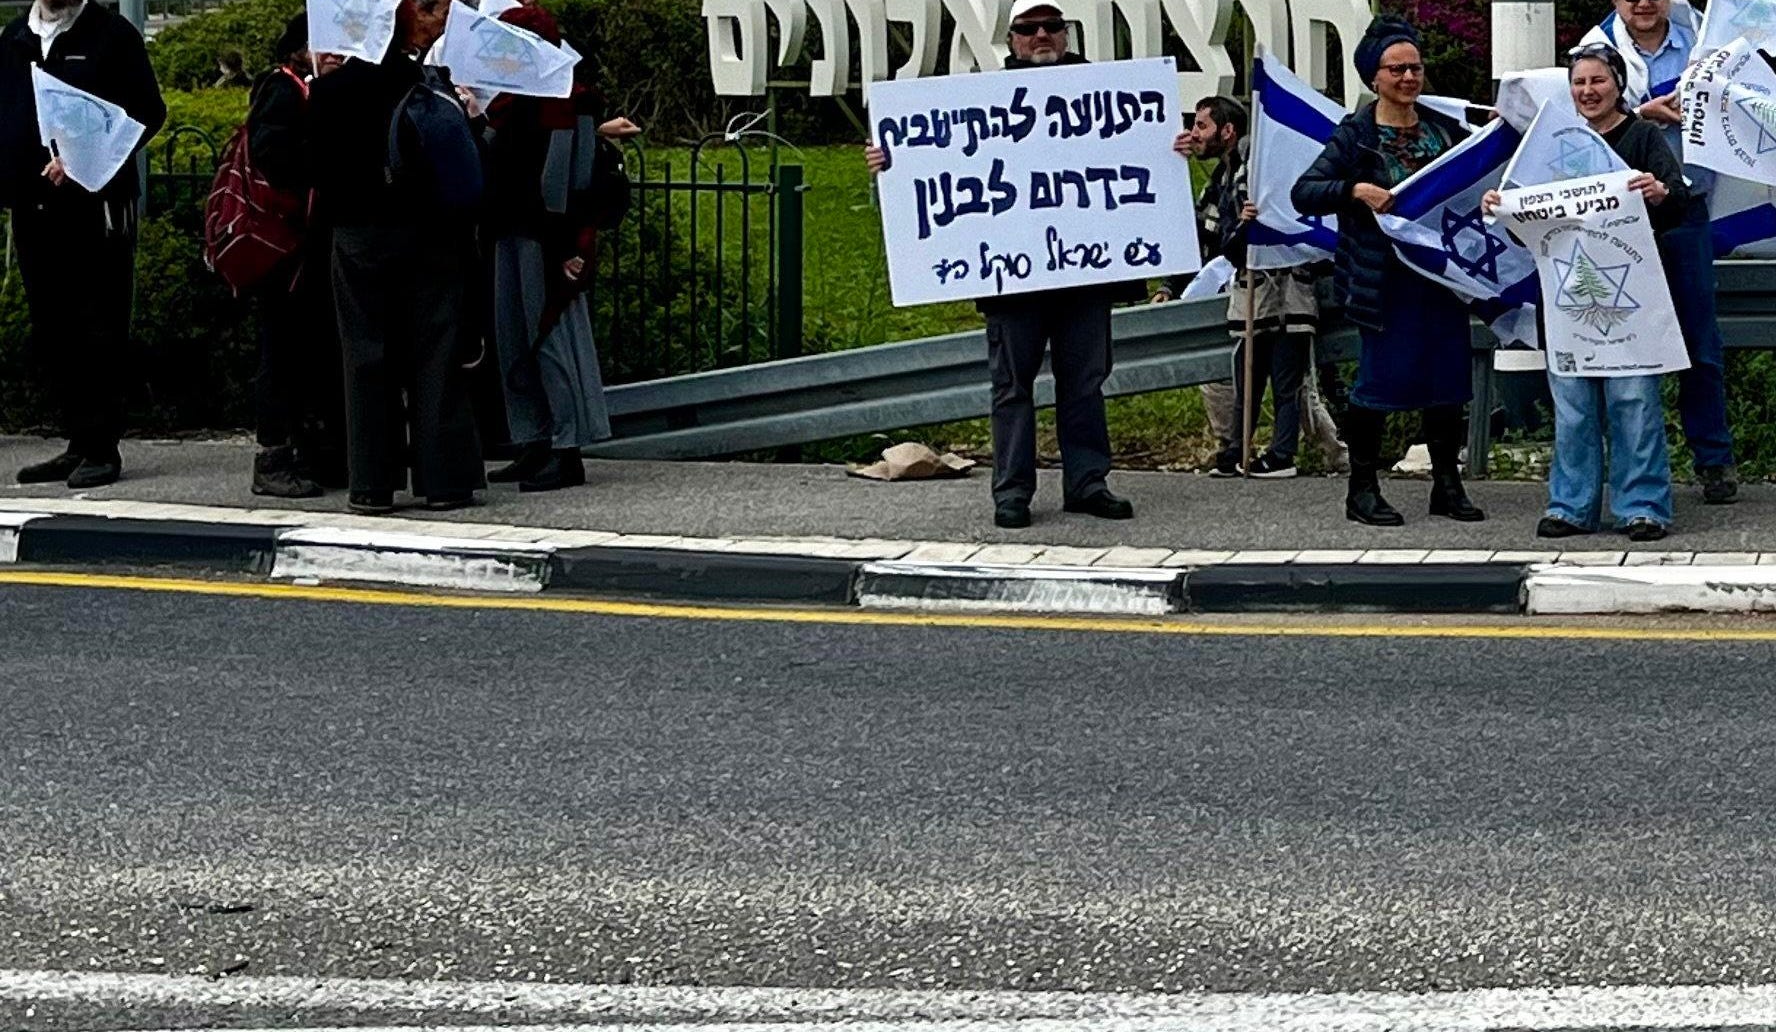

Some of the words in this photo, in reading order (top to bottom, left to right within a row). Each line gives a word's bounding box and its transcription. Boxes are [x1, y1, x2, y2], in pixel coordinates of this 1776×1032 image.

[1045, 90, 1166, 140] התנועה
[913, 157, 1018, 240] לבנון
[1029, 164, 1157, 211] בדרום
[1576, 195, 1620, 216] מגיע
